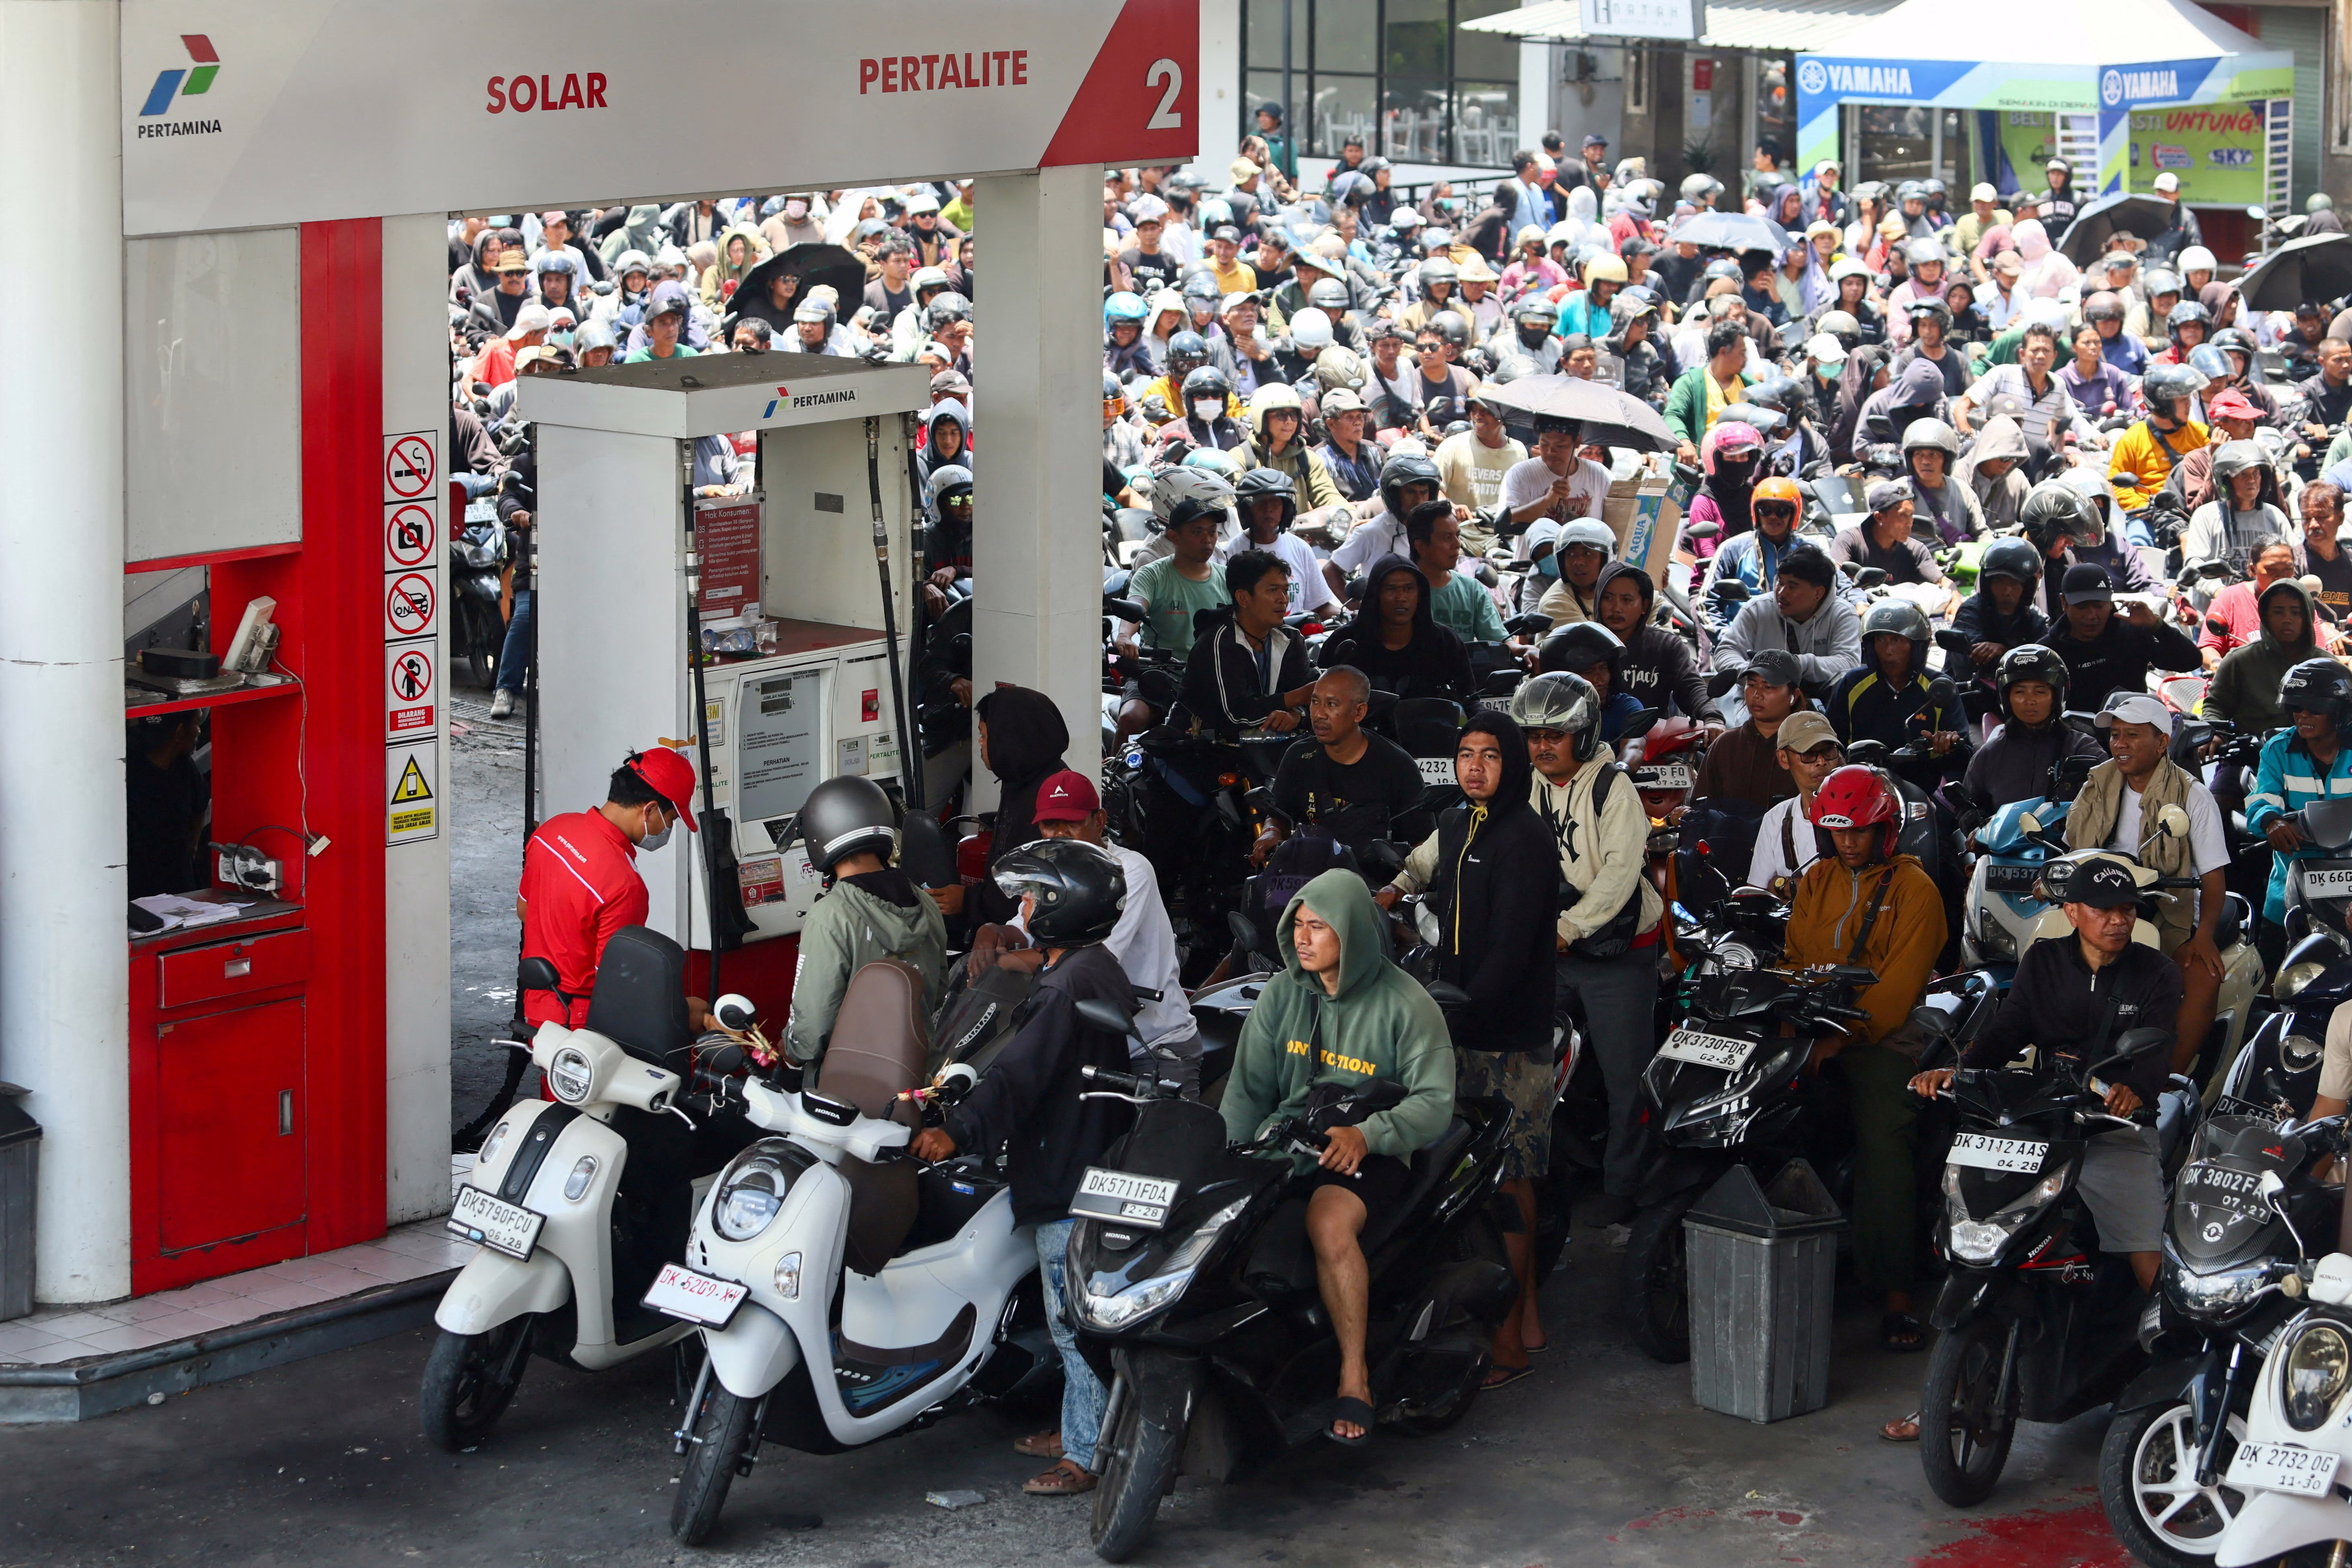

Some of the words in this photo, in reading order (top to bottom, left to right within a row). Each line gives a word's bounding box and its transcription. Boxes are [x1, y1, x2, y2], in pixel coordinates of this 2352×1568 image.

[860, 49, 1028, 94] PERTALITE
[1828, 65, 1913, 94] YAMAHA
[486, 72, 608, 114] SOLAR
[2122, 70, 2178, 99] YAMAHA
[1145, 58, 1183, 129] 2
[138, 119, 222, 139] PERTAMINA
[2166, 110, 2263, 137] UNTUNG!
[793, 390, 856, 408] PERTAMINA
[705, 511, 717, 519] Hak
[719, 509, 751, 517] Konsumen:
[1630, 519, 1647, 554] AQUA
[396, 605, 410, 615] ON
[398, 709, 425, 719] DILARANG
[707, 704, 719, 720] 3M
[764, 757, 790, 766] PERHATIAN
[869, 749, 899, 759] PERTALITE
[2093, 867, 2130, 883] Callaway
[2309, 873, 2326, 884] DK
[815, 1108, 840, 1120] HONDA
[1952, 1134, 1974, 1147] DK
[1975, 1137, 2014, 1154] 3112
[2016, 1141, 2048, 1157] AAS
[2185, 1168, 2202, 1184] DK
[1089, 1175, 1167, 1203] DK5711FDA
[462, 1191, 533, 1233] DK5790FCU
[453, 1222, 470, 1235] YAMAHA
[1105, 1232, 1131, 1241] HONDA
[2028, 1234, 2053, 1258] HONDA
[659, 1269, 681, 1286] DK
[2319, 1274, 2342, 1282] HONDA
[2239, 1444, 2262, 1462] DK
[2267, 1449, 2310, 1470] 2732
